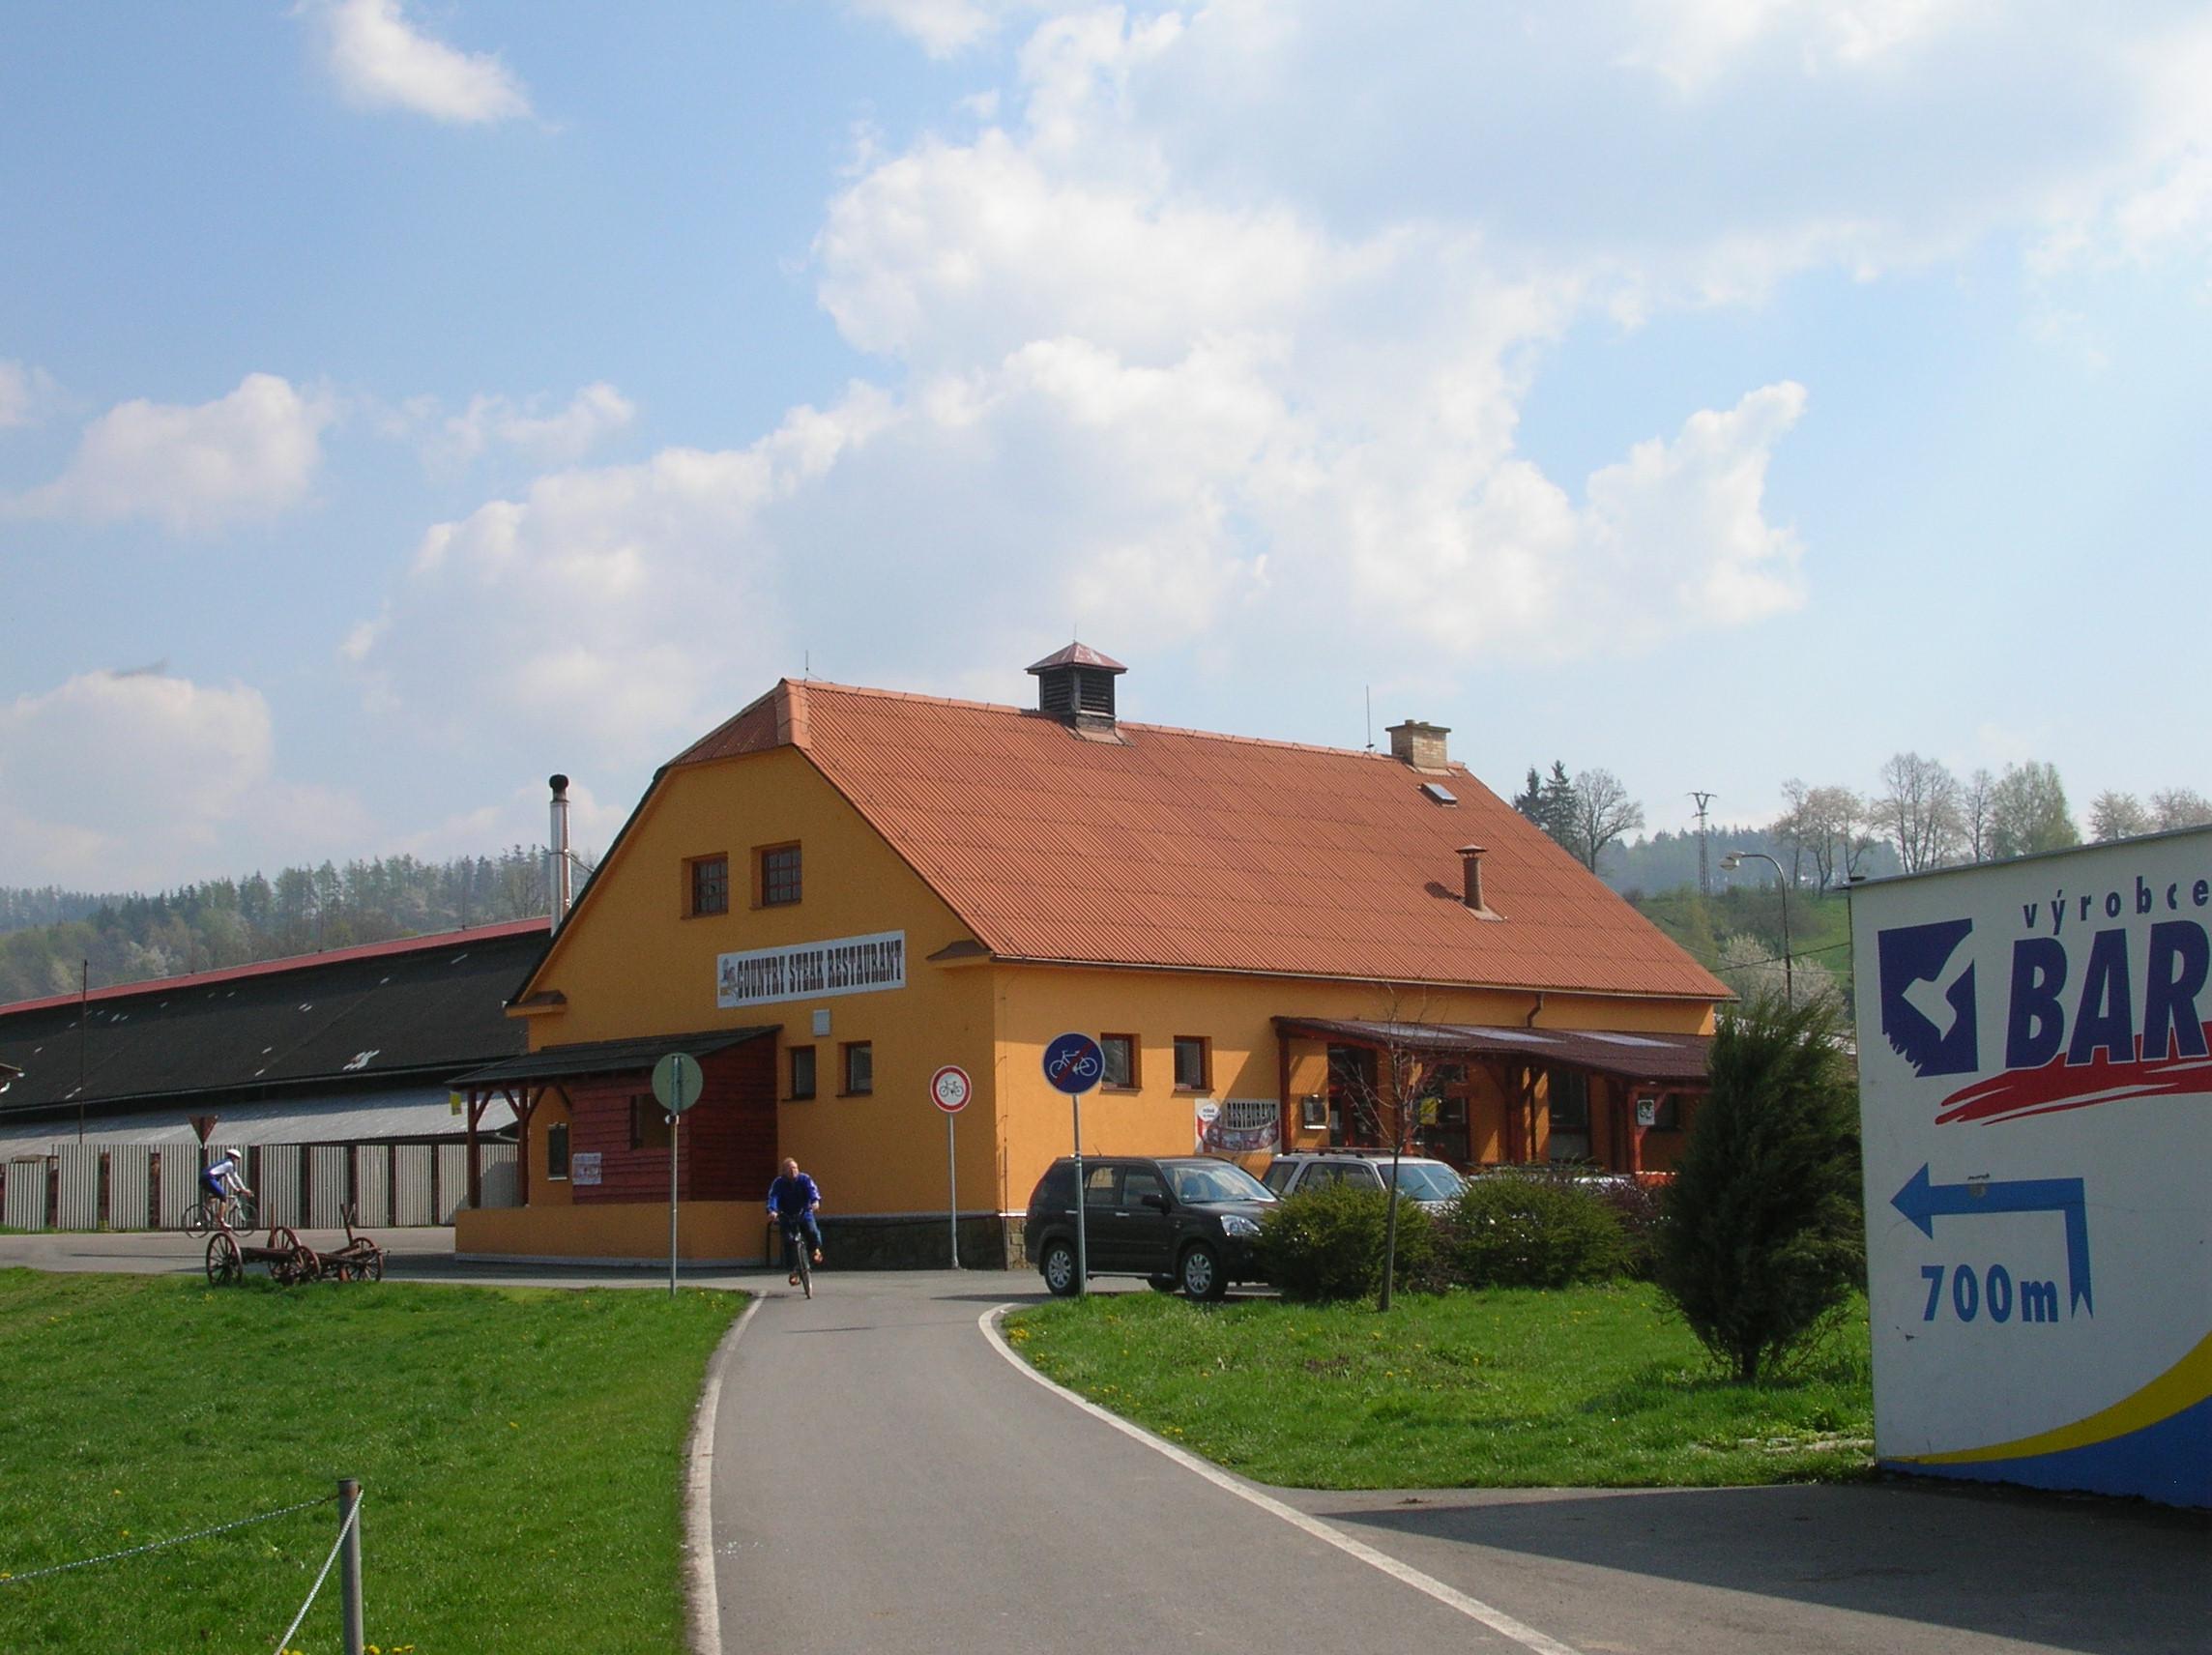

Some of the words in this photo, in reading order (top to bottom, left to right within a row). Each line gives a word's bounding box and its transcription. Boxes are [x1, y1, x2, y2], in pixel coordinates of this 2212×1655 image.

[2023, 875, 2210, 937] výrobce
[737, 954, 786, 1000] COUNTRY
[789, 949, 825, 993] STEAK
[827, 939, 903, 989] RESTAURANT
[1920, 1263, 2059, 1323] 700m
